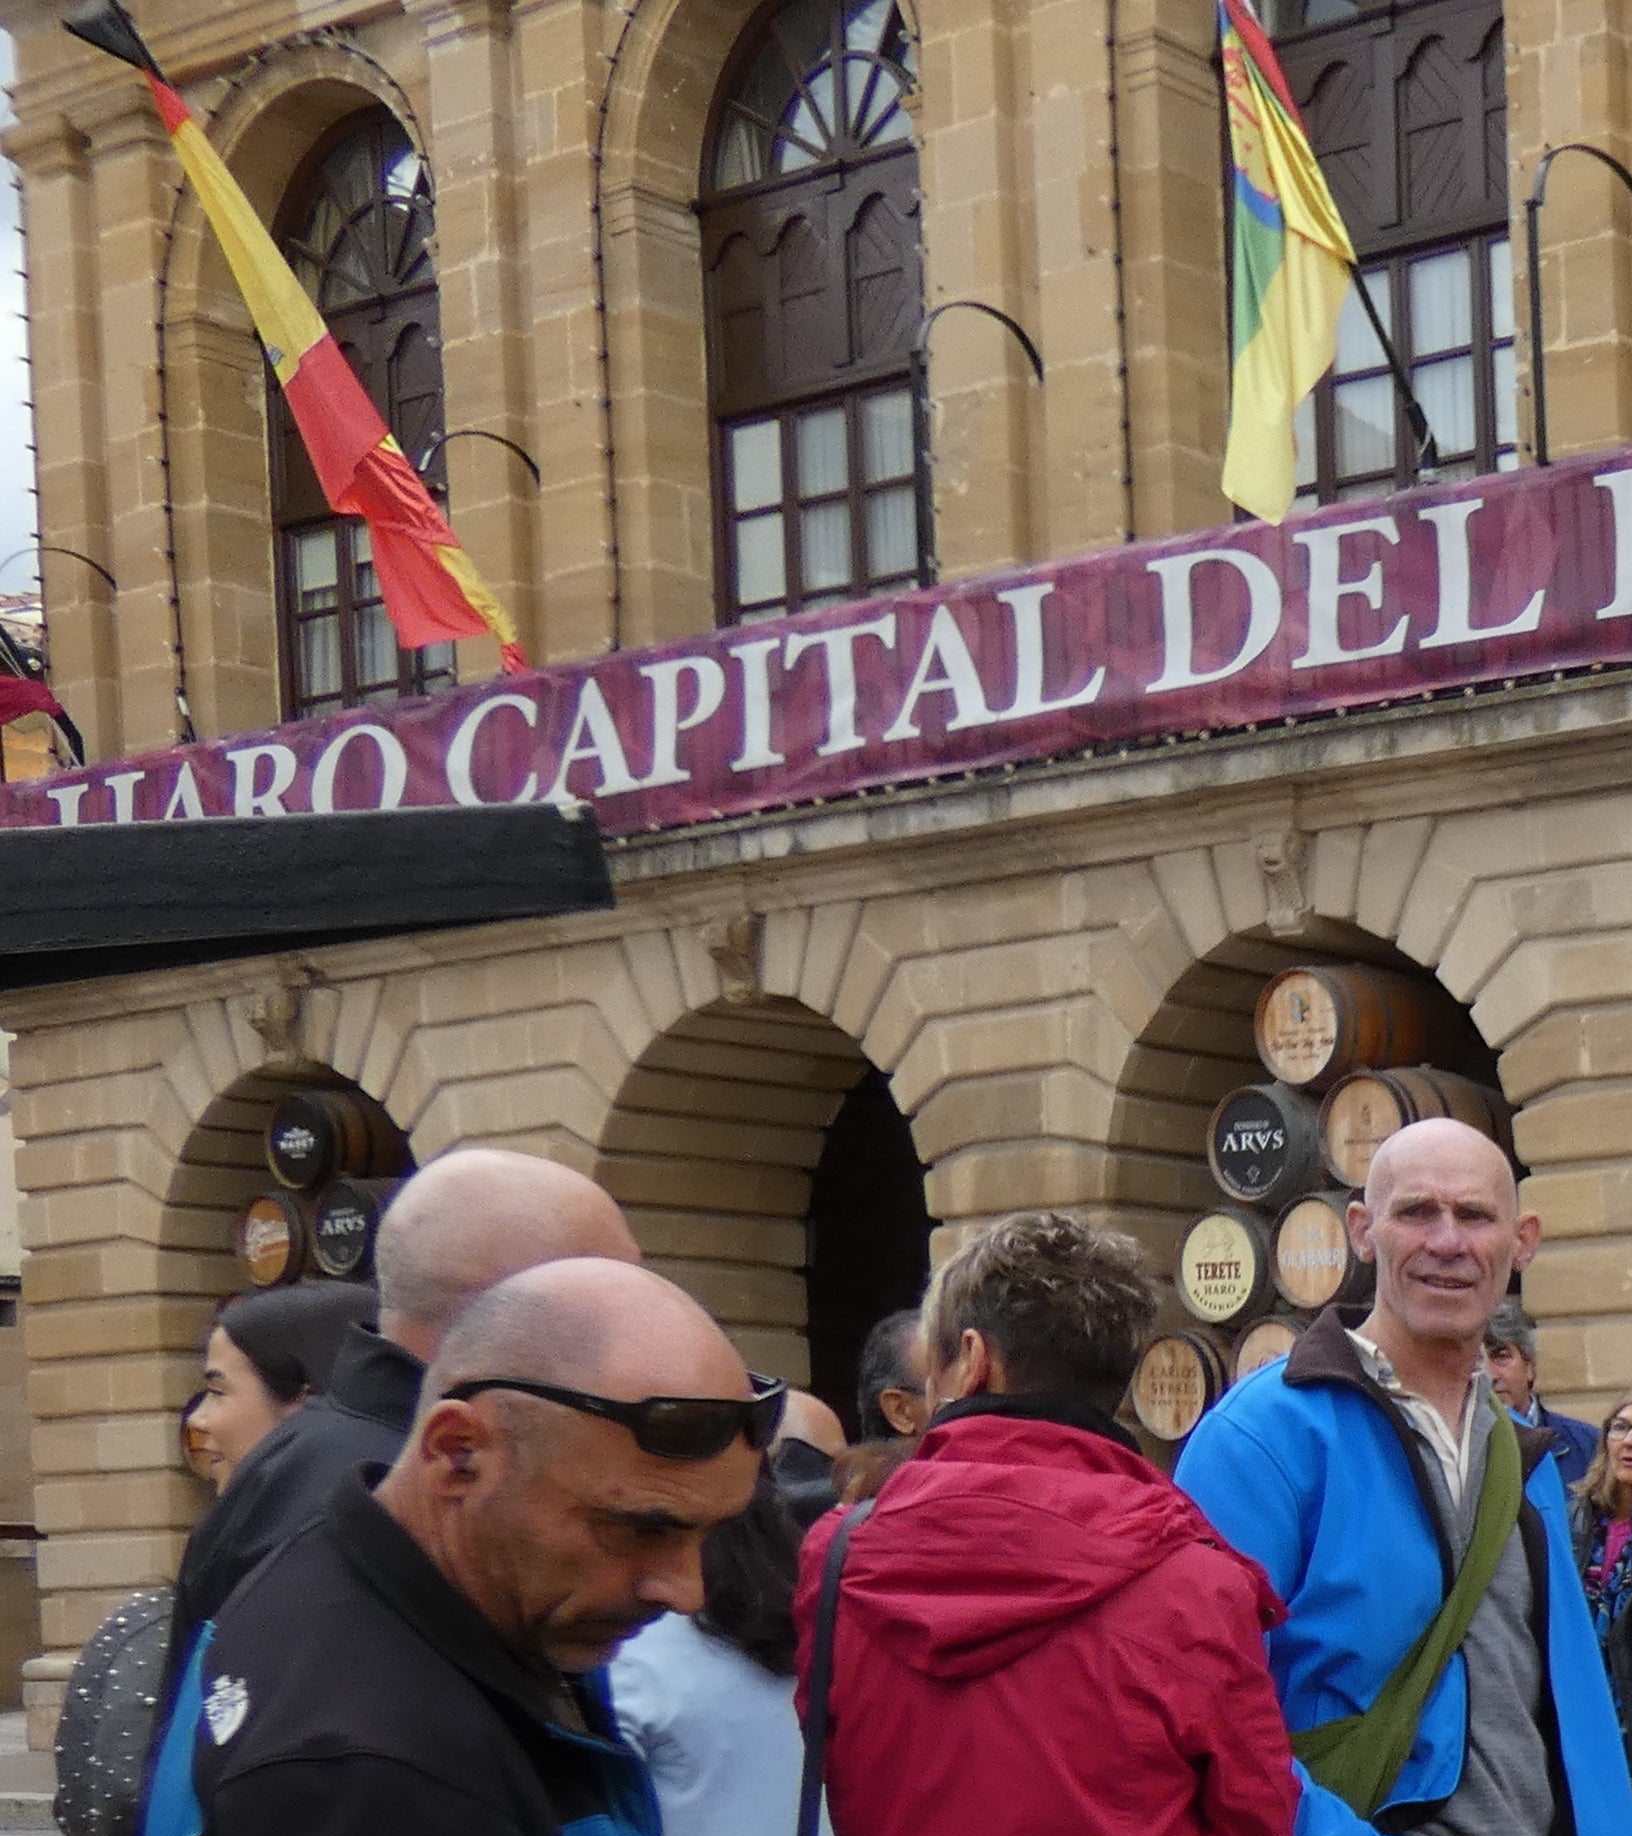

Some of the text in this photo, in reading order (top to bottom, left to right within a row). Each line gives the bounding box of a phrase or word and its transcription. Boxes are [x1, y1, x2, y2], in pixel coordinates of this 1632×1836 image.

[446, 581, 1106, 806] CAPITAL
[1146, 497, 1547, 696] DEL
[1195, 1261, 1241, 1281] TERETE
